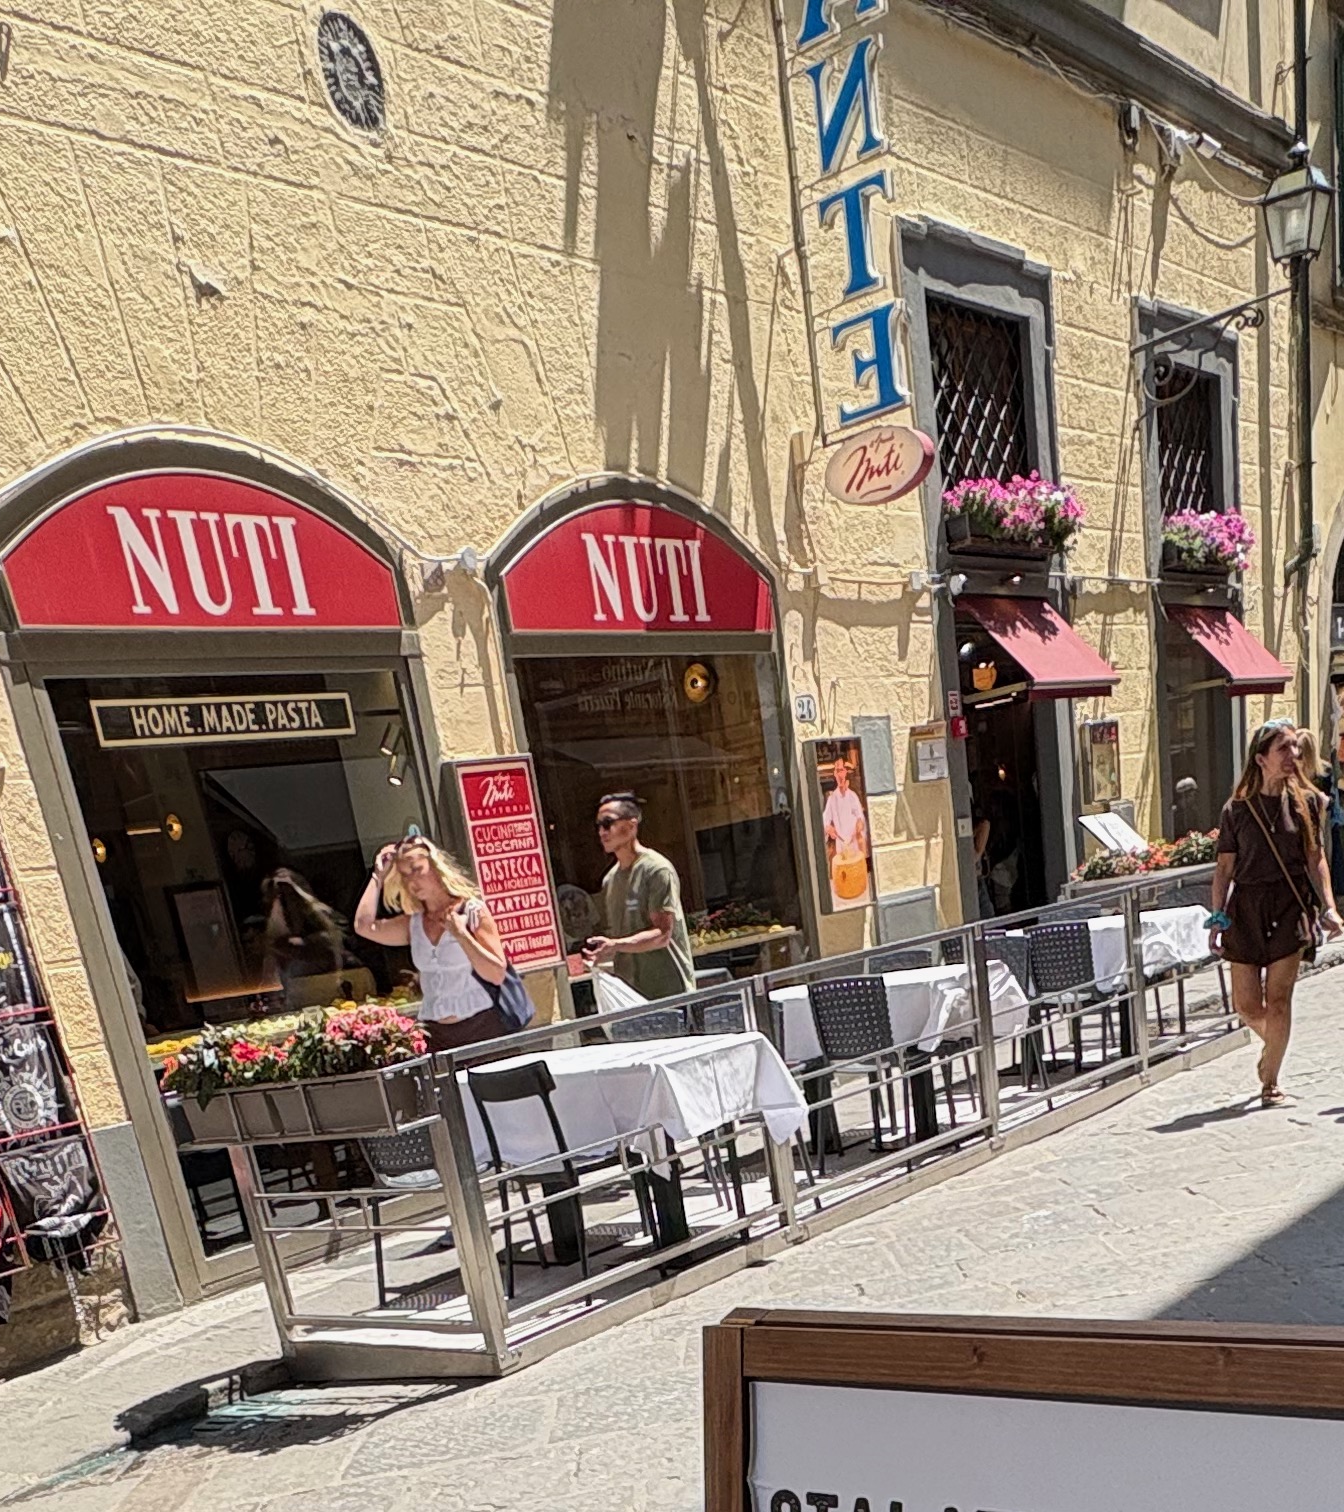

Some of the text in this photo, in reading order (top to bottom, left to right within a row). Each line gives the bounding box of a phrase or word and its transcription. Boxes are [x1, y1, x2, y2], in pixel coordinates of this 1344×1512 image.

[106, 505, 317, 616] NUTI
[581, 533, 711, 622] NUTI
[470, 804, 531, 818] TRATTORIA
[474, 824, 515, 843] CUCINA
[477, 836, 535, 855] TOSCANA
[480, 857, 541, 883] BISTECCA
[487, 891, 548, 915] TARTUFO
